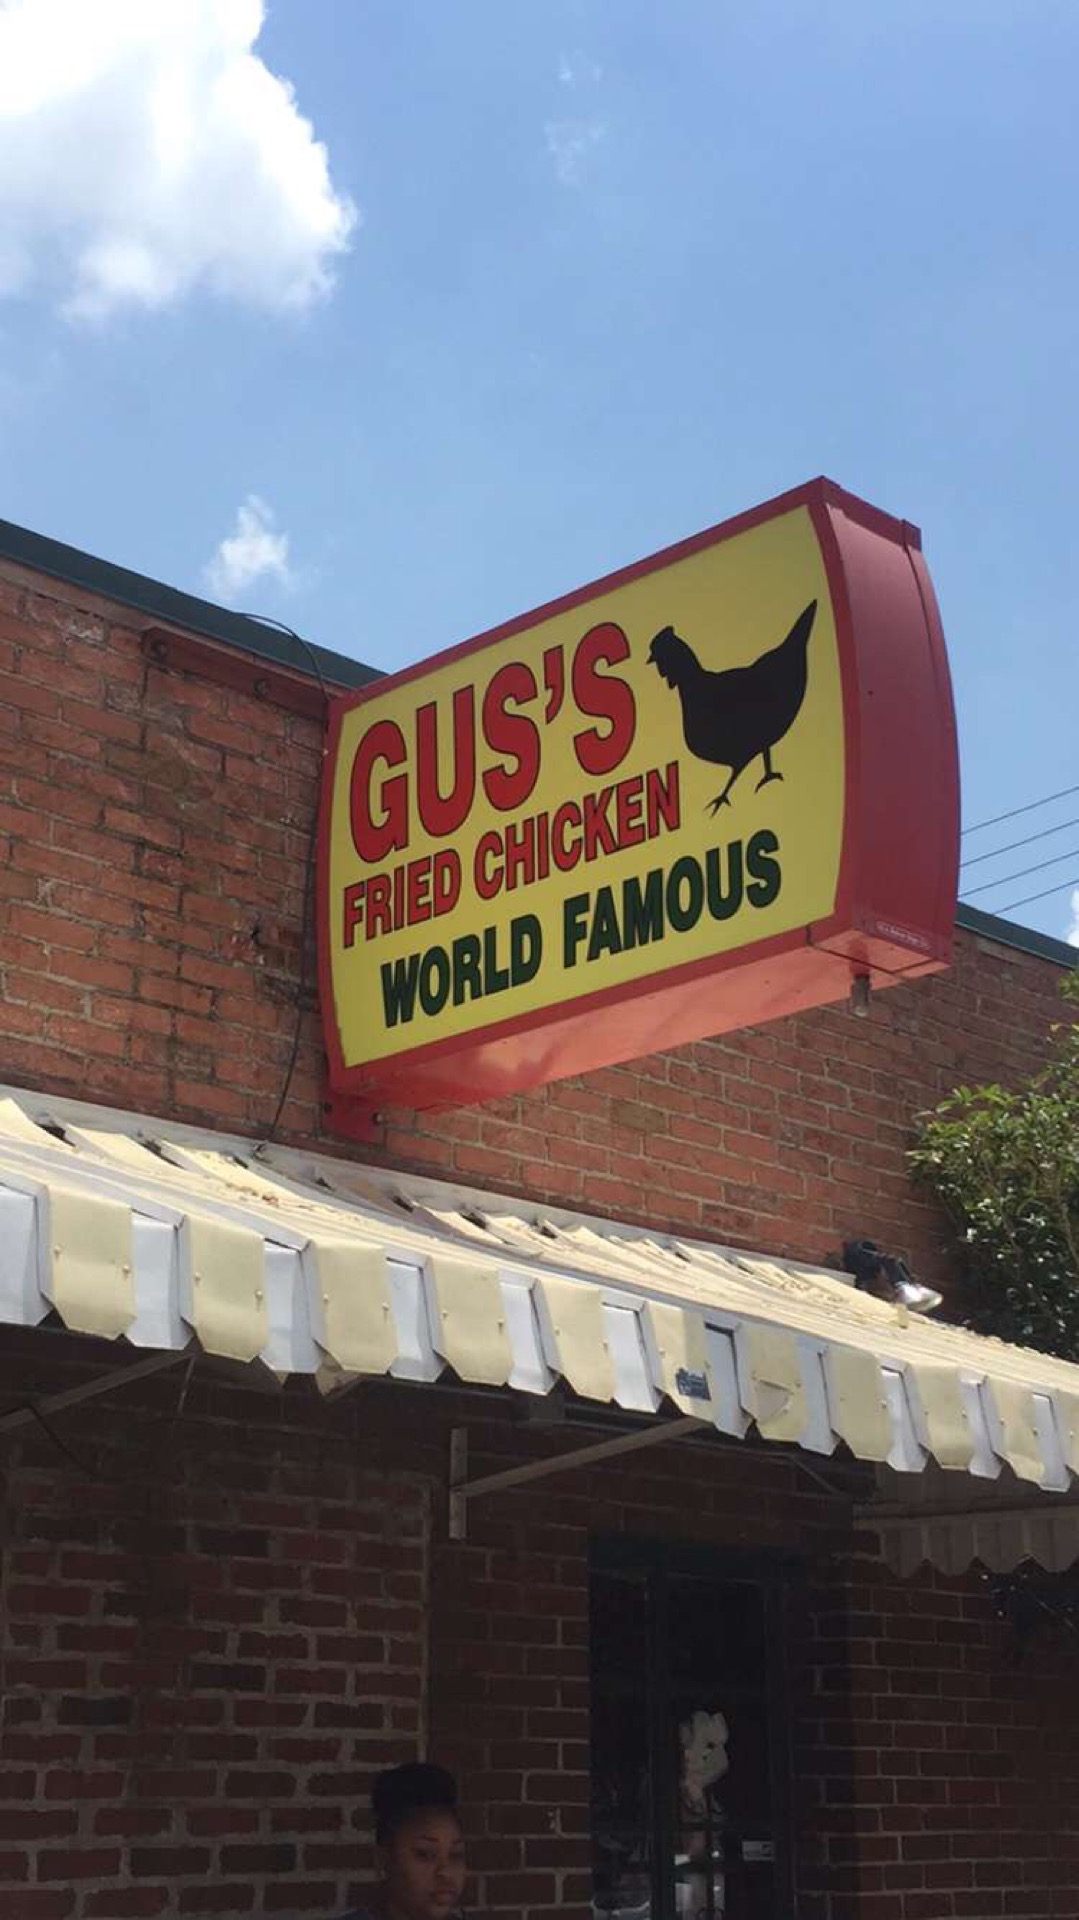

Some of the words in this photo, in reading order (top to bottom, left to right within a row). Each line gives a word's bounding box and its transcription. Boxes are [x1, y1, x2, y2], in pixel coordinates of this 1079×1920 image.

[350, 622, 636, 863] GUS'S
[343, 847, 461, 948] FRIED
[474, 760, 681, 901] CHICKEN
[380, 913, 542, 1029] WORLD
[563, 829, 782, 968] FAMOUS
